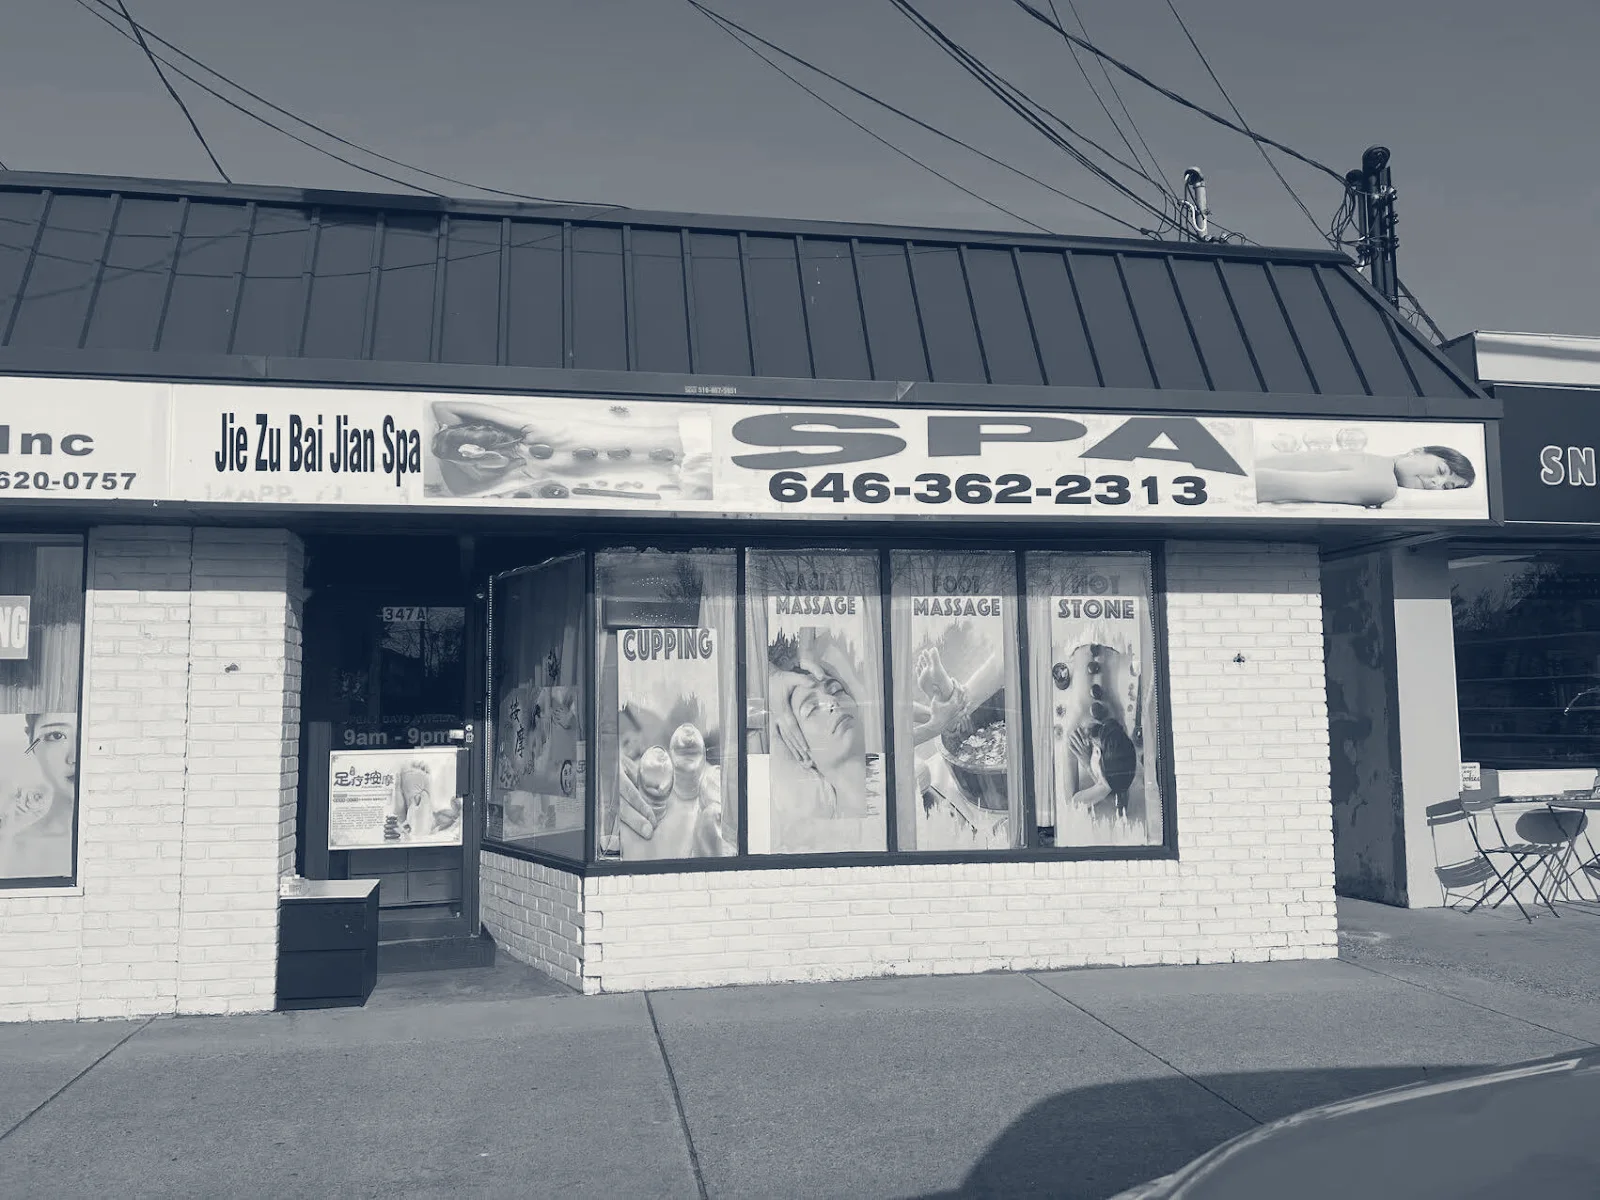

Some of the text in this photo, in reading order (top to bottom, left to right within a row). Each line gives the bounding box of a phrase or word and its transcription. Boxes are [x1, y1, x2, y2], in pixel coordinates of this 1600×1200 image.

[0, 425, 94, 456] Inc
[215, 412, 421, 487] Jie Zu Bai Jian Spa
[731, 412, 1248, 477] SPA
[1540, 445, 1597, 486] SN
[0, 471, 137, 490] 620-0757
[768, 471, 1209, 506] 646-362-2313
[933, 575, 980, 594] FOOT
[1072, 575, 1120, 595] HOT
[385, 608, 426, 620] 347A
[775, 596, 857, 615] MASSAGE
[914, 597, 1001, 617] MASSAGE
[1058, 598, 1135, 620] STONE
[623, 628, 713, 662] CUPPING
[344, 729, 387, 745] 9am
[407, 728, 451, 749] 9pm
[333, 769, 394, 787] 足疗按摩
